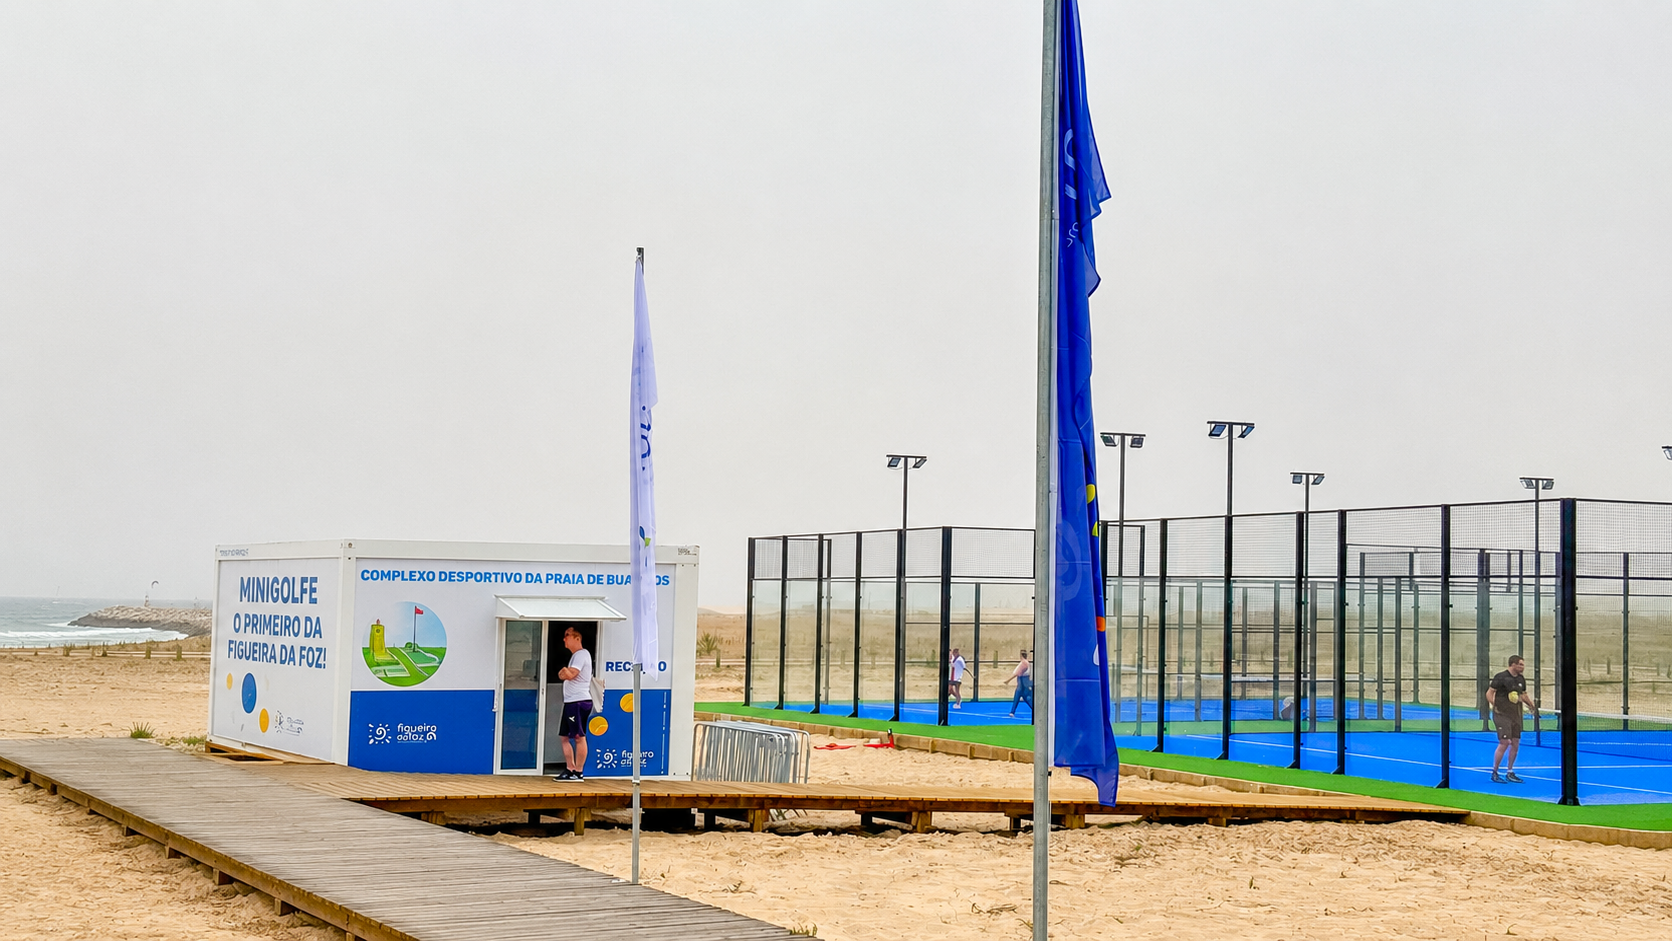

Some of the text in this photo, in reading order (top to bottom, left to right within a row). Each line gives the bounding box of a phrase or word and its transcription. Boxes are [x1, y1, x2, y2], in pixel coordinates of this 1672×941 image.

[239, 576, 318, 604] MINIGOLFE
[360, 569, 670, 586] COMPLEXO DESPORTIVO DA PRAIA DE BUAOS
[233, 612, 322, 639] O PRIMEIRO DA
[227, 639, 327, 669] FIGUEIRA DA FOZ!
[605, 661, 667, 674] RECO
